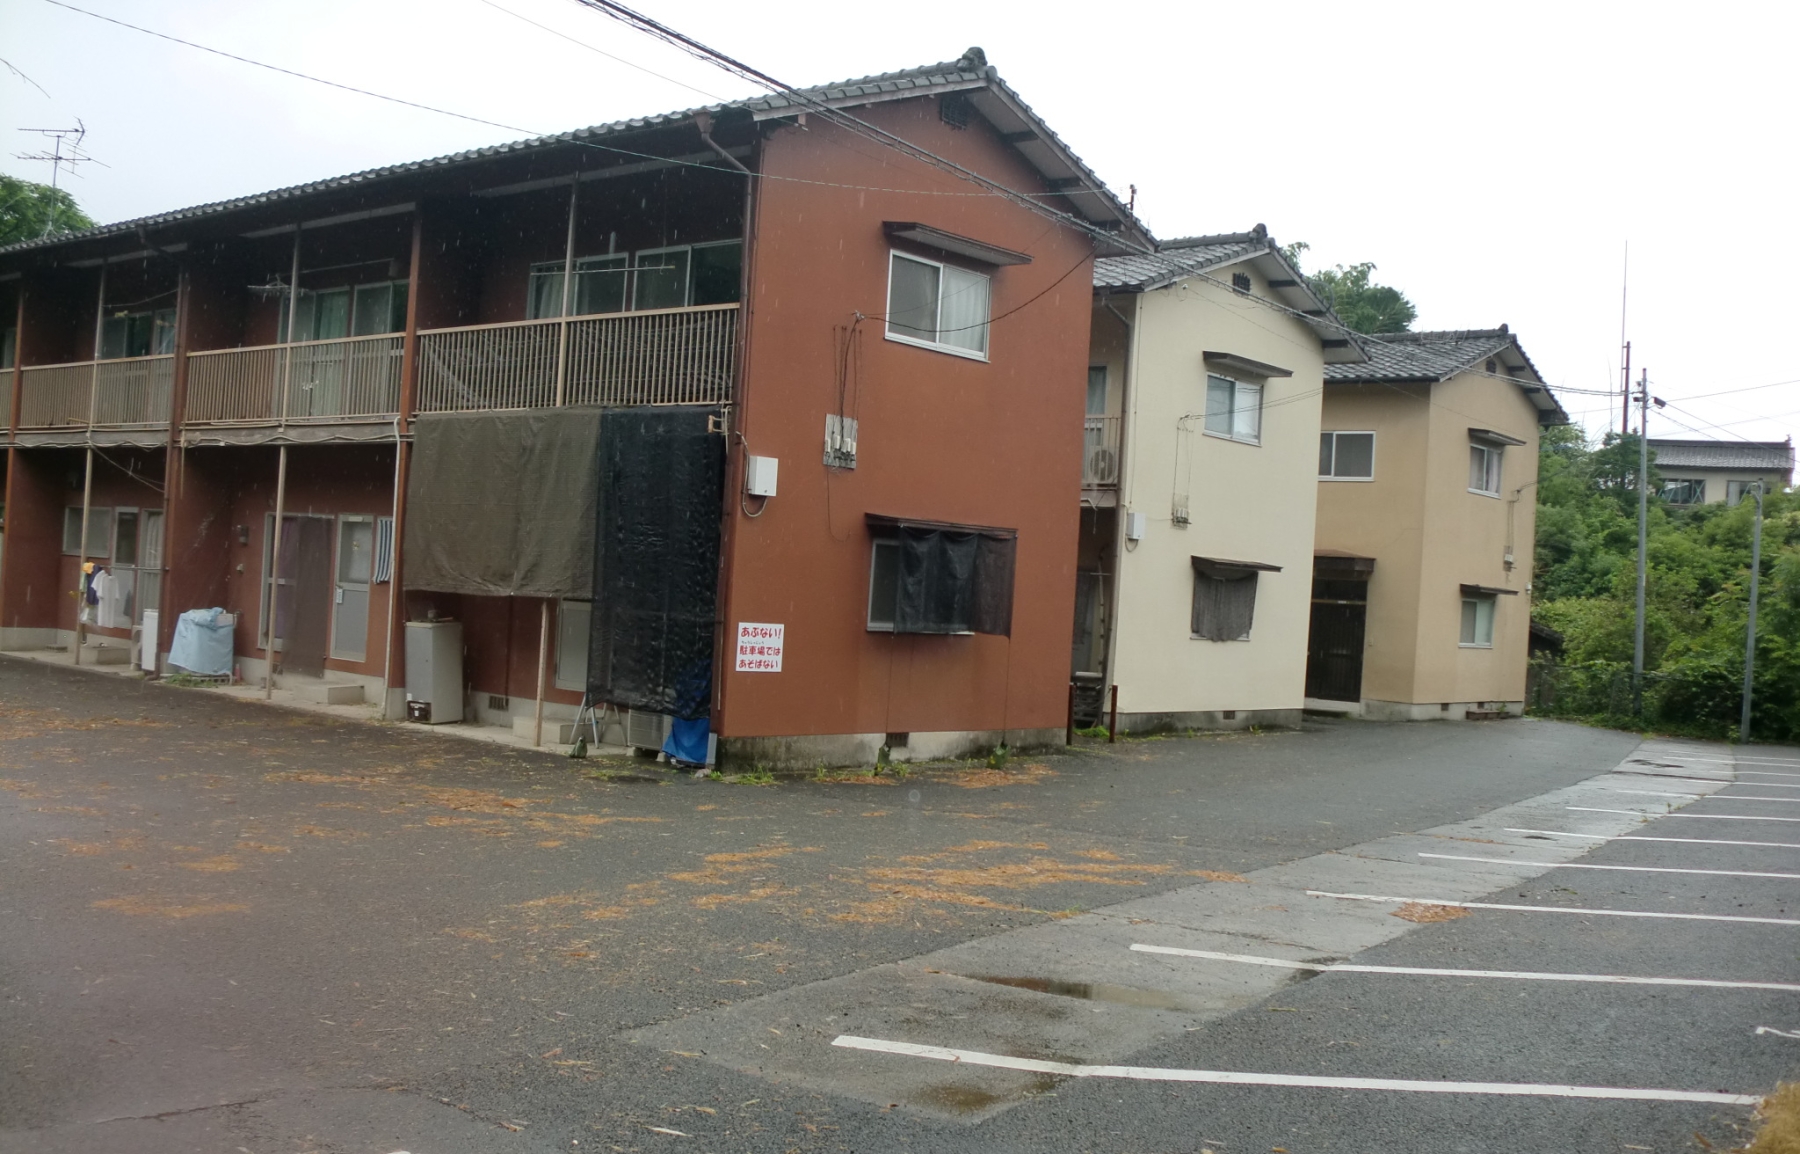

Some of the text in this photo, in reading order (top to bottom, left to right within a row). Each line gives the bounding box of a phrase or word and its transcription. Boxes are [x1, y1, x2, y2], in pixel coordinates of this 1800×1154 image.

[739, 645, 781, 656] 駐車場では
[738, 659, 778, 669] あそばない
